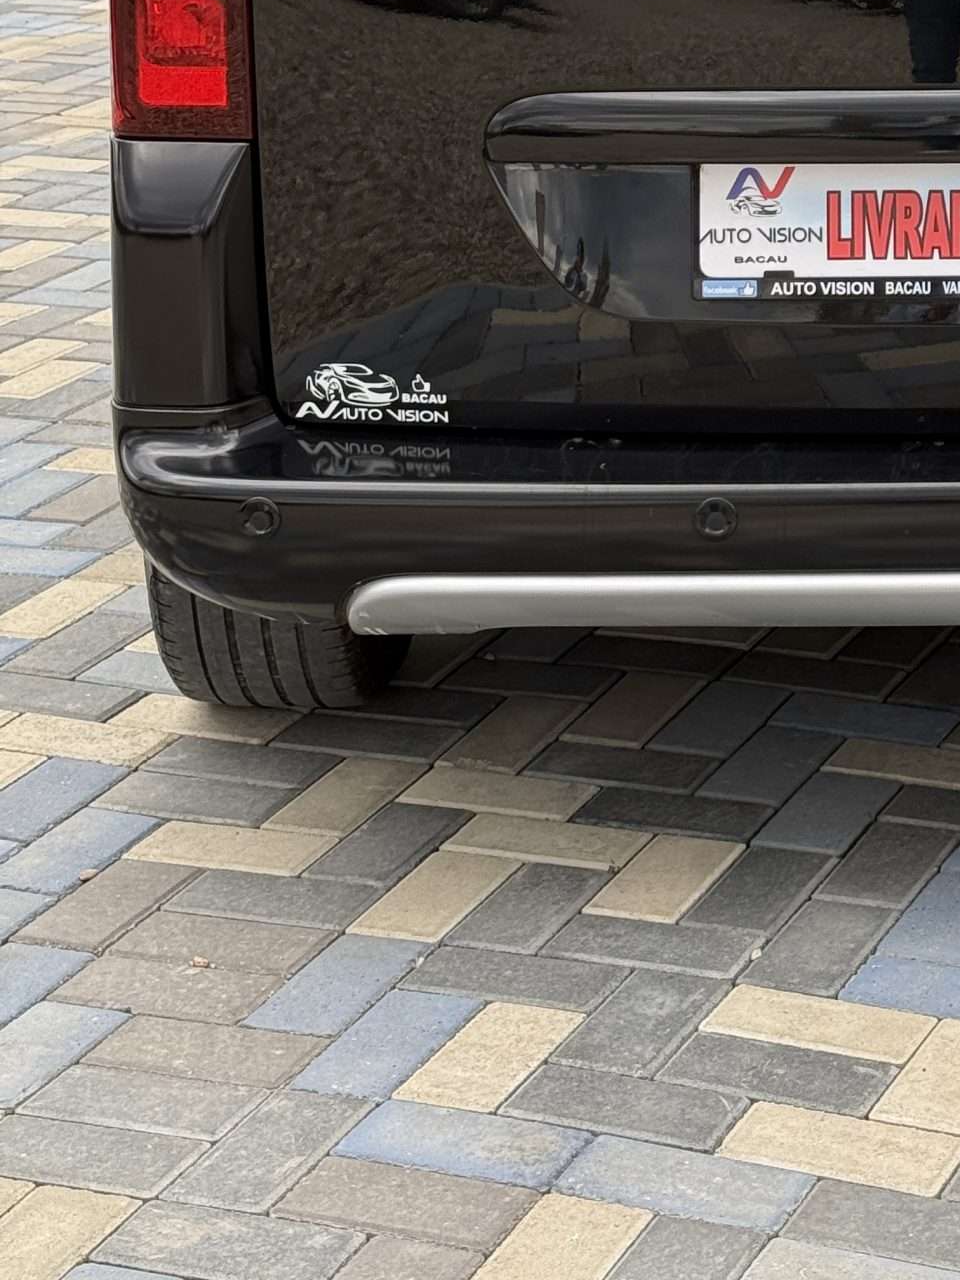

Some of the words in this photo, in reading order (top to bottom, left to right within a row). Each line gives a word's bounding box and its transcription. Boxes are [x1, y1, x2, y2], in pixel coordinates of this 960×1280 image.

[700, 228, 752, 244] AUTO
[757, 226, 823, 243] VISION
[734, 256, 788, 264] BACAU
[771, 281, 817, 296] AUTO
[820, 281, 875, 295] VISION
[885, 280, 932, 295] BACAU
[401, 393, 447, 404] BACAU
[332, 408, 383, 421] AUTO
[386, 409, 449, 423] VISION
